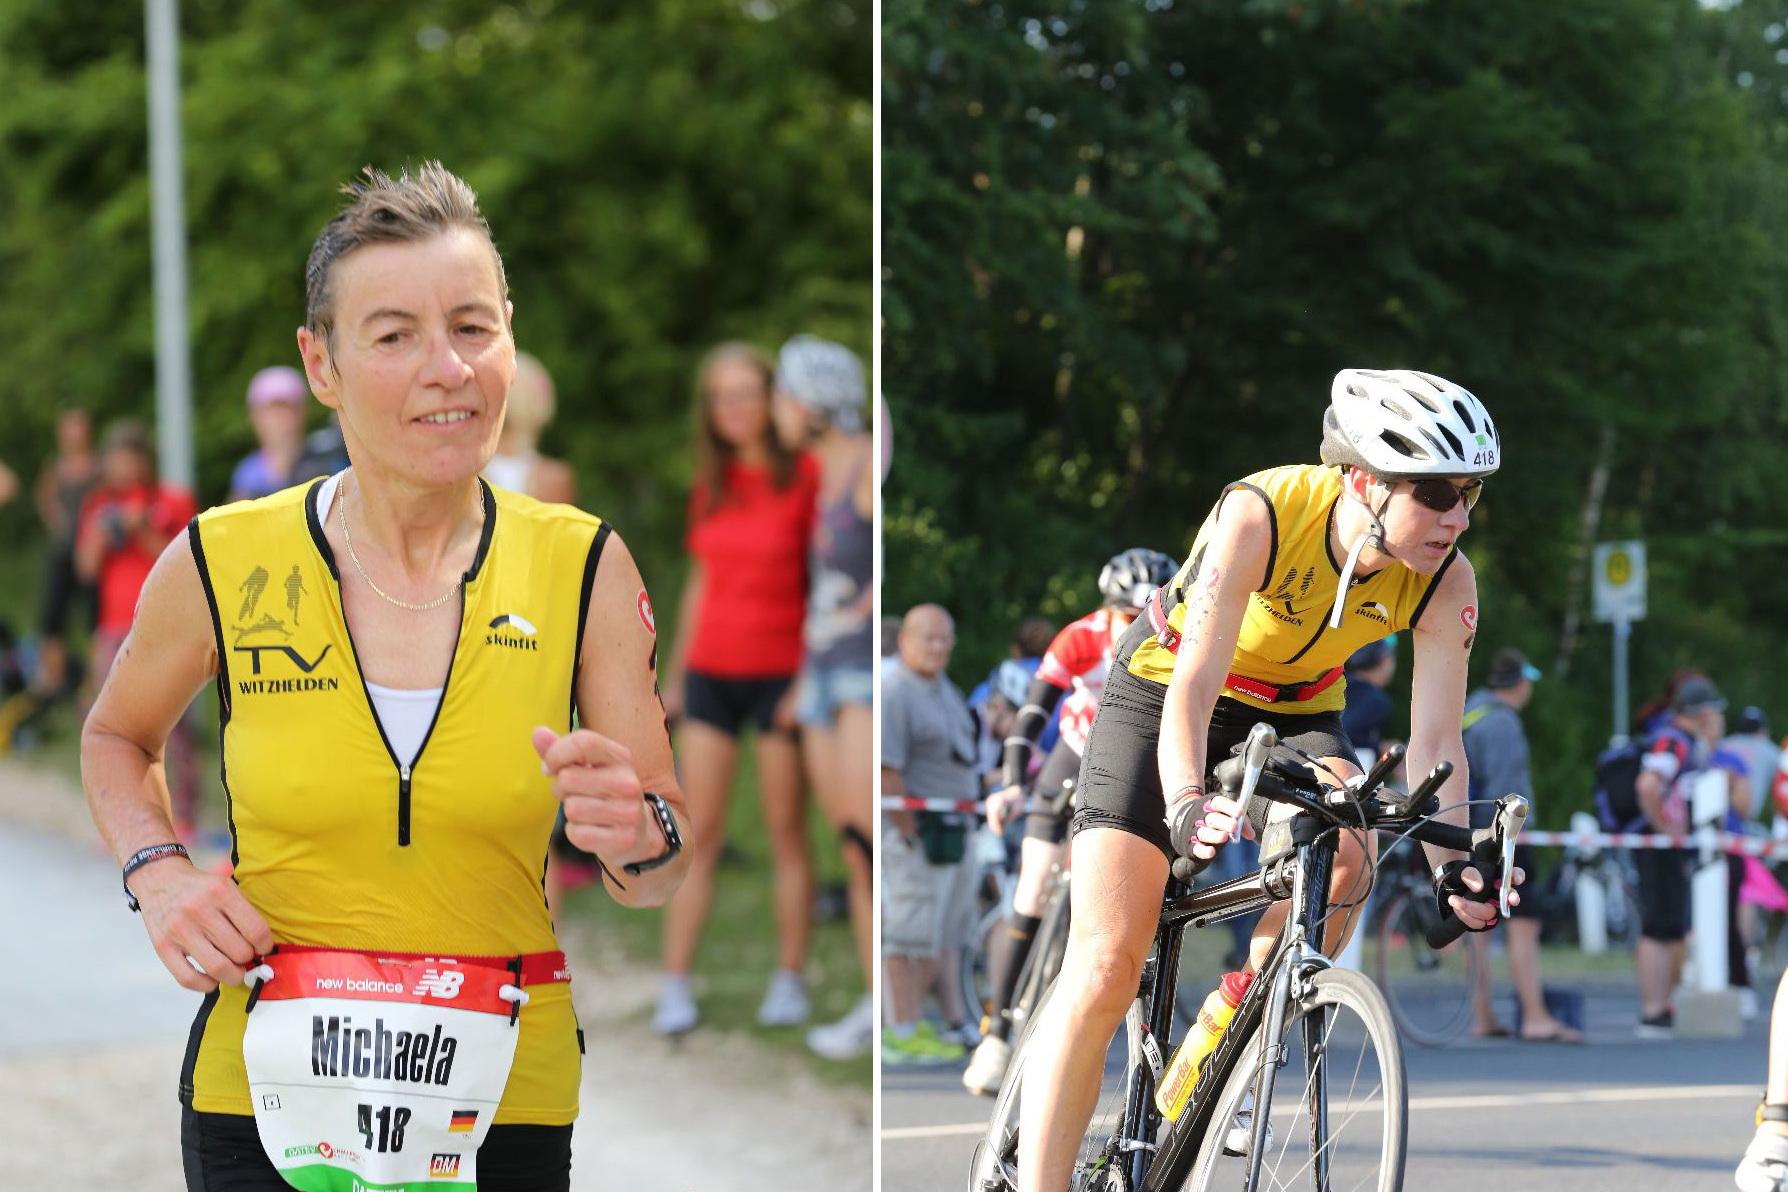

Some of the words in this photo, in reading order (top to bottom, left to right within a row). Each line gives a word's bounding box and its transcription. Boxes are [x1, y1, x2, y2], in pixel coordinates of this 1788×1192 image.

[1473, 450, 1495, 467] 418
[485, 634, 538, 651] skinfit
[233, 643, 333, 675] TV
[239, 677, 339, 695] WITZHELDEN
[316, 978, 343, 990] new
[346, 977, 404, 993] balance
[412, 968, 465, 1000] NB
[311, 1015, 458, 1086] Michaela
[1162, 1056, 1191, 1108] PowerBar
[356, 1103, 412, 1154] 418
[433, 1156, 457, 1174] DM
